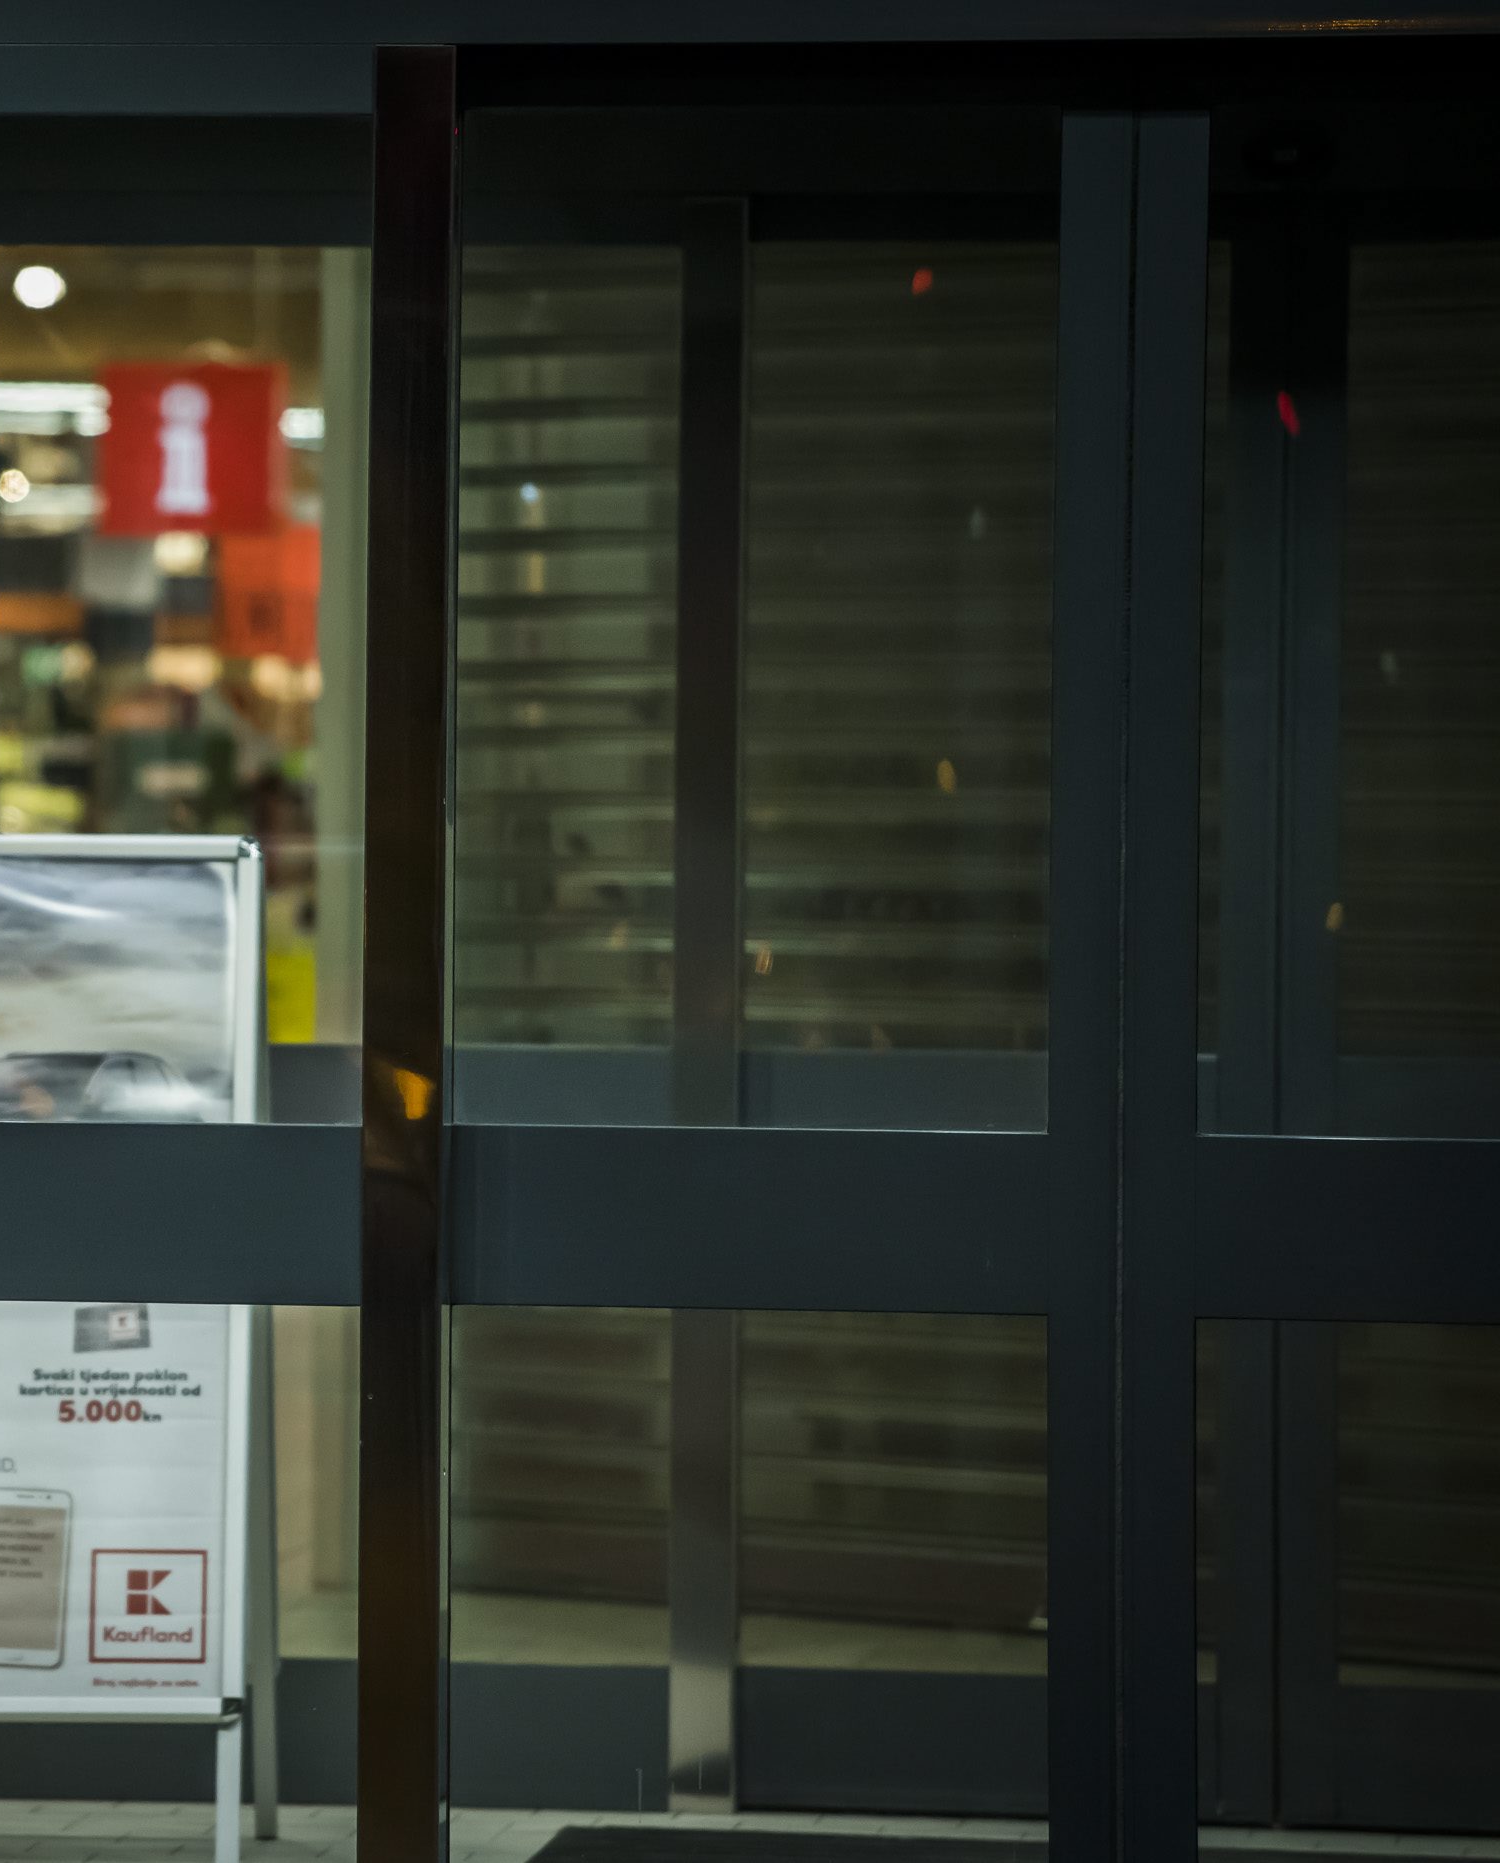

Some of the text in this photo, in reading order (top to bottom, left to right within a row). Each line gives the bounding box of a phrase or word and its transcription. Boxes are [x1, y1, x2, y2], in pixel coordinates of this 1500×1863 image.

[32, 1368, 188, 1385] Svaki tjedan poklon
[18, 1383, 201, 1398] kartica u vrijednosti od
[103, 1625, 193, 1643] Kaufland
